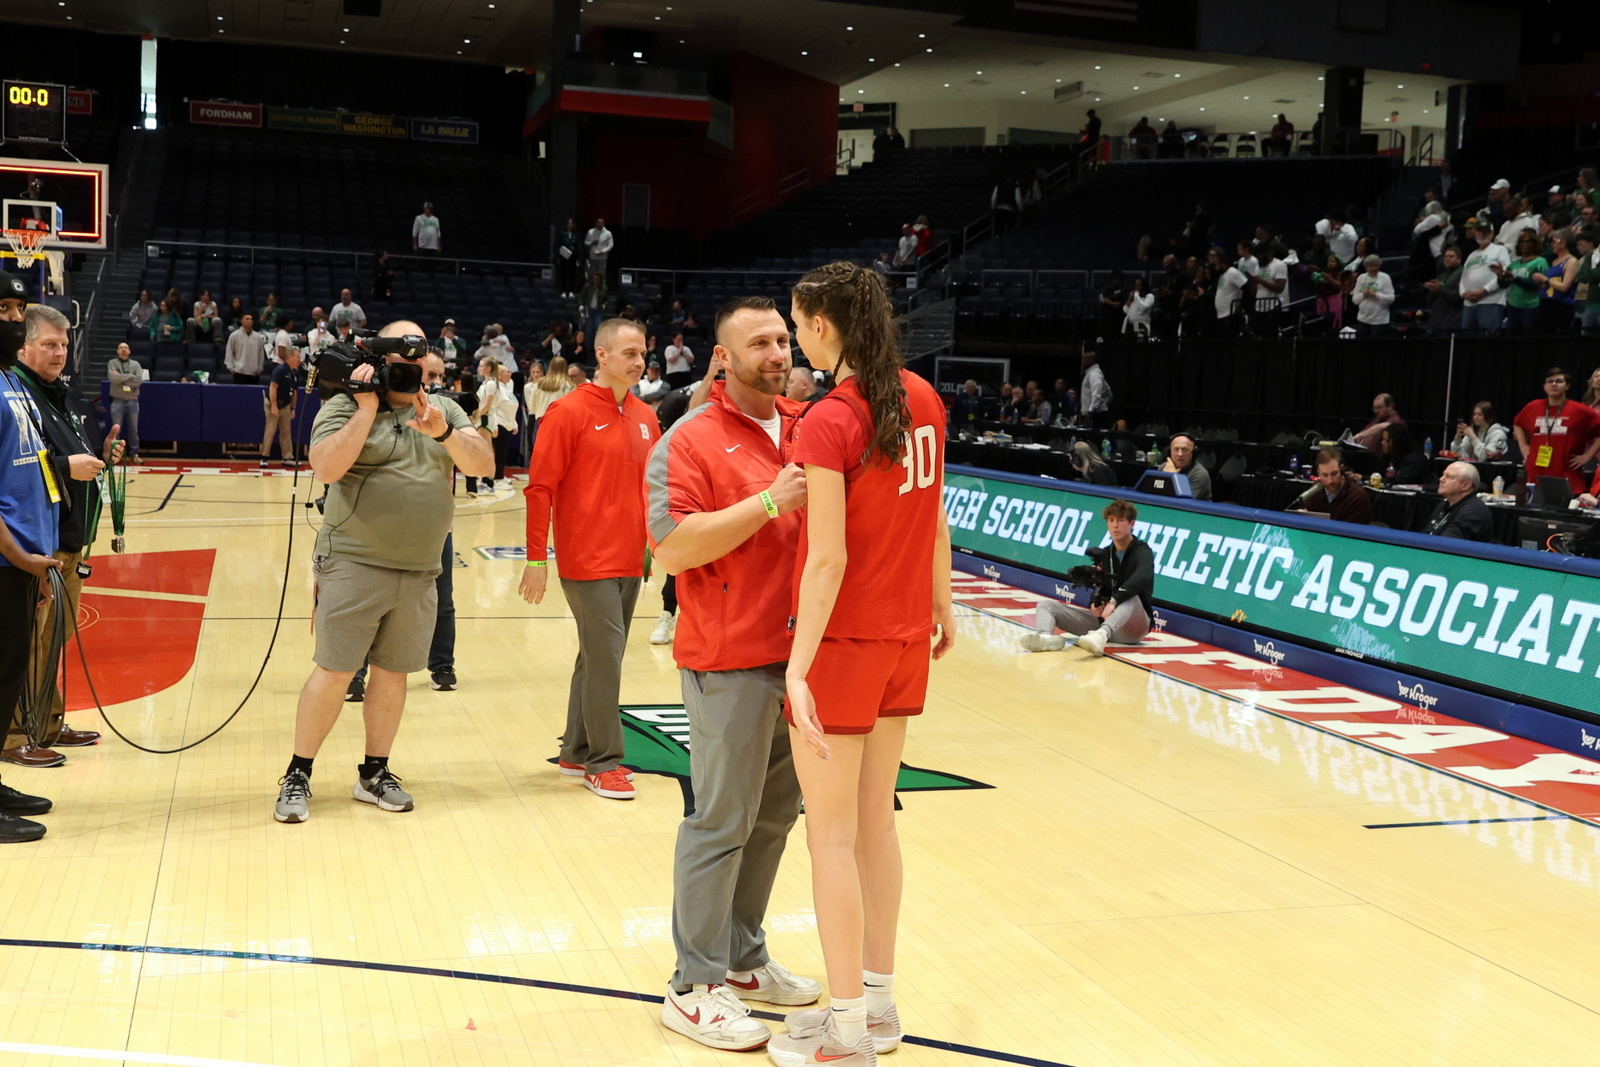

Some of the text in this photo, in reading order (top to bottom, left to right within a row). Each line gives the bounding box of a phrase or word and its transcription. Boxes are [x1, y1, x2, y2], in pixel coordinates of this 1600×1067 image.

[200, 108, 253, 121] FORDHAM
[354, 115, 393, 127] GEORGE
[342, 124, 406, 136] WASHINGTON
[421, 124, 436, 135] LA
[638, 422, 650, 440] B
[943, 485, 989, 531] IGH
[982, 495, 1093, 557] SCHOOL
[1291, 554, 1600, 677] ASSOCIAT
[1262, 641, 1286, 665] Kroger
[1409, 683, 1439, 710] Kroger
[1218, 686, 1600, 788] DAY
